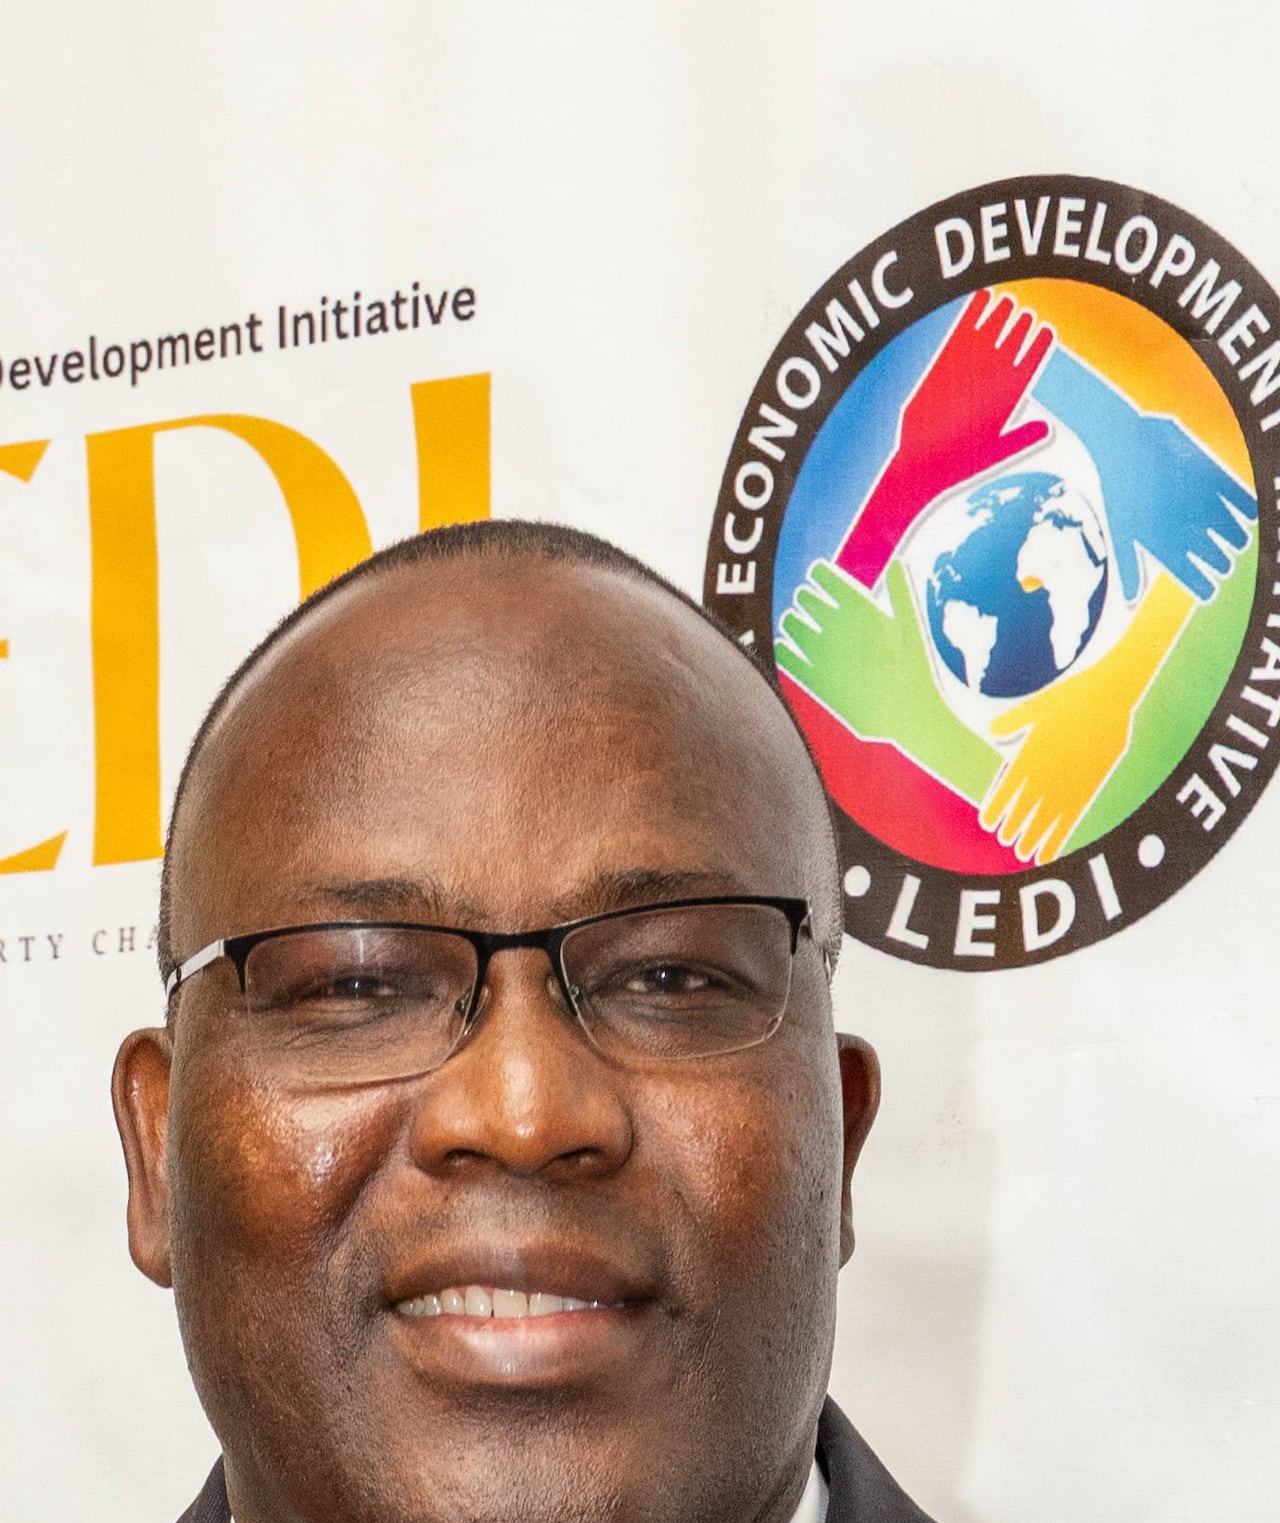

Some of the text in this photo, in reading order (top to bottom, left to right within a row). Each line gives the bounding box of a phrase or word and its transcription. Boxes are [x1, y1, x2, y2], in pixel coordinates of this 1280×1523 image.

[279, 284, 476, 348] Initiative
[716, 250, 914, 596] ECONOMIC
[888, 867, 1122, 957] LEDI
